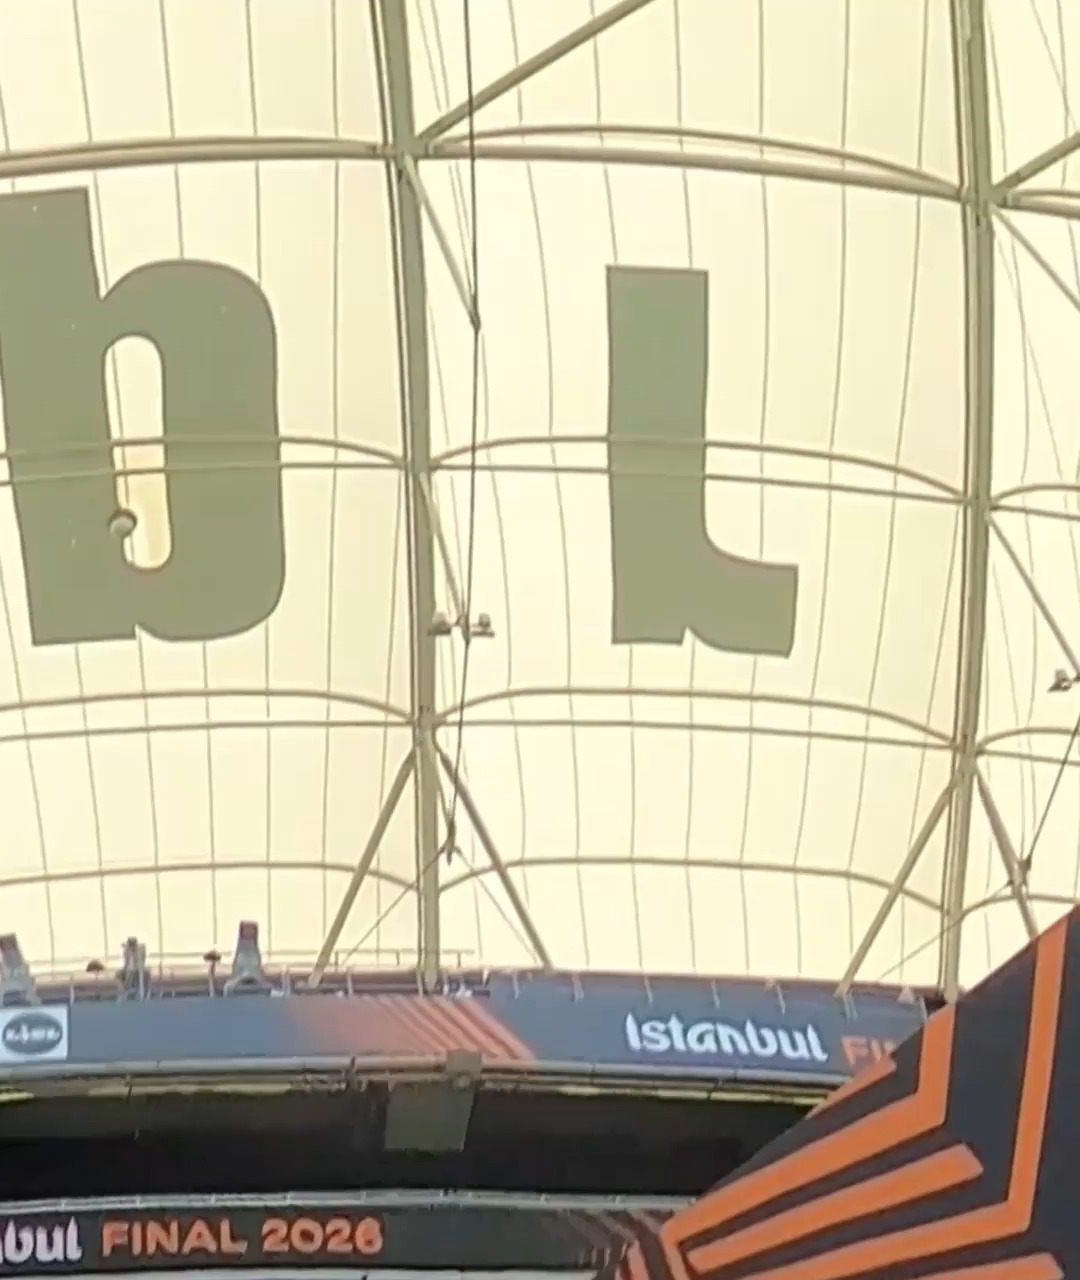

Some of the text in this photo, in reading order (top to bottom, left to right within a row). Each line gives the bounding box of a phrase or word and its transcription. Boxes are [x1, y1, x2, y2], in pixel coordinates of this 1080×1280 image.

[625, 1012, 828, 1062] Istanbul
[102, 1219, 248, 1257] FINAL
[261, 1216, 385, 1255] 2026
